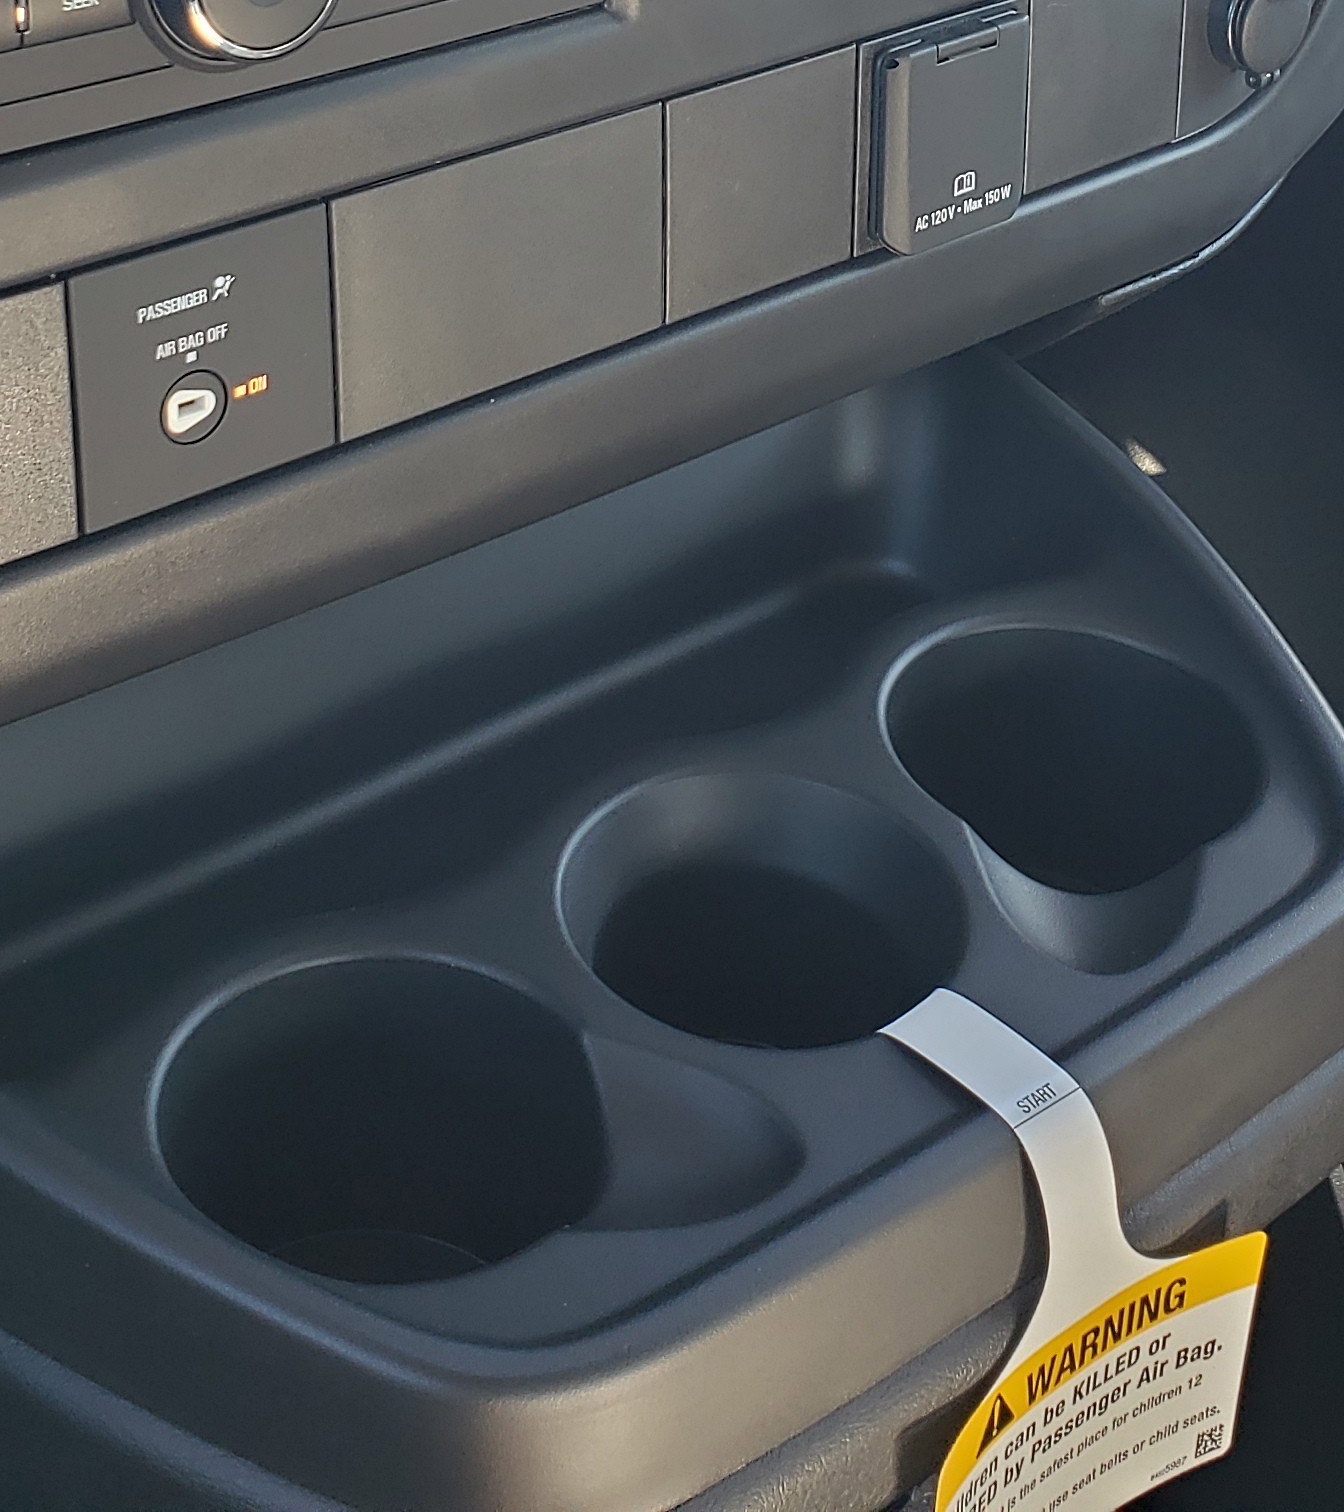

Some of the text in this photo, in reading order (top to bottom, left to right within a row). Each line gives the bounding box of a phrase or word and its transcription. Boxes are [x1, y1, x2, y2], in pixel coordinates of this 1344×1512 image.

[915, 214, 929, 233] AC
[963, 198, 983, 215] Max
[137, 288, 209, 324] PASSENGER
[156, 323, 229, 360] AIR BAG OFF
[248, 374, 268, 396] ON
[1016, 1082, 1057, 1114] START
[1026, 1276, 1188, 1407] WARNING
[1003, 1456, 1025, 1489] by
[1031, 1379, 1132, 1464] Passenger
[1137, 1359, 1169, 1389] Air
[1175, 1338, 1223, 1370] Bag.
[1004, 1421, 1036, 1460] can
[1043, 1399, 1066, 1428] be
[1072, 1345, 1141, 1405] KILLED
[1148, 1332, 1172, 1356] or
[1019, 1478, 1037, 1501] the
[1039, 1447, 1075, 1483] safest
[1076, 1425, 1109, 1458] place
[1112, 1412, 1130, 1431] for
[1132, 1385, 1183, 1418] children
[1188, 1373, 1204, 1390] 12
[1072, 1467, 1097, 1495] seat
[1099, 1449, 1129, 1476] belts
[1132, 1439, 1146, 1455] or
[1148, 1419, 1180, 1446] child
[1182, 1405, 1221, 1430] seats.
